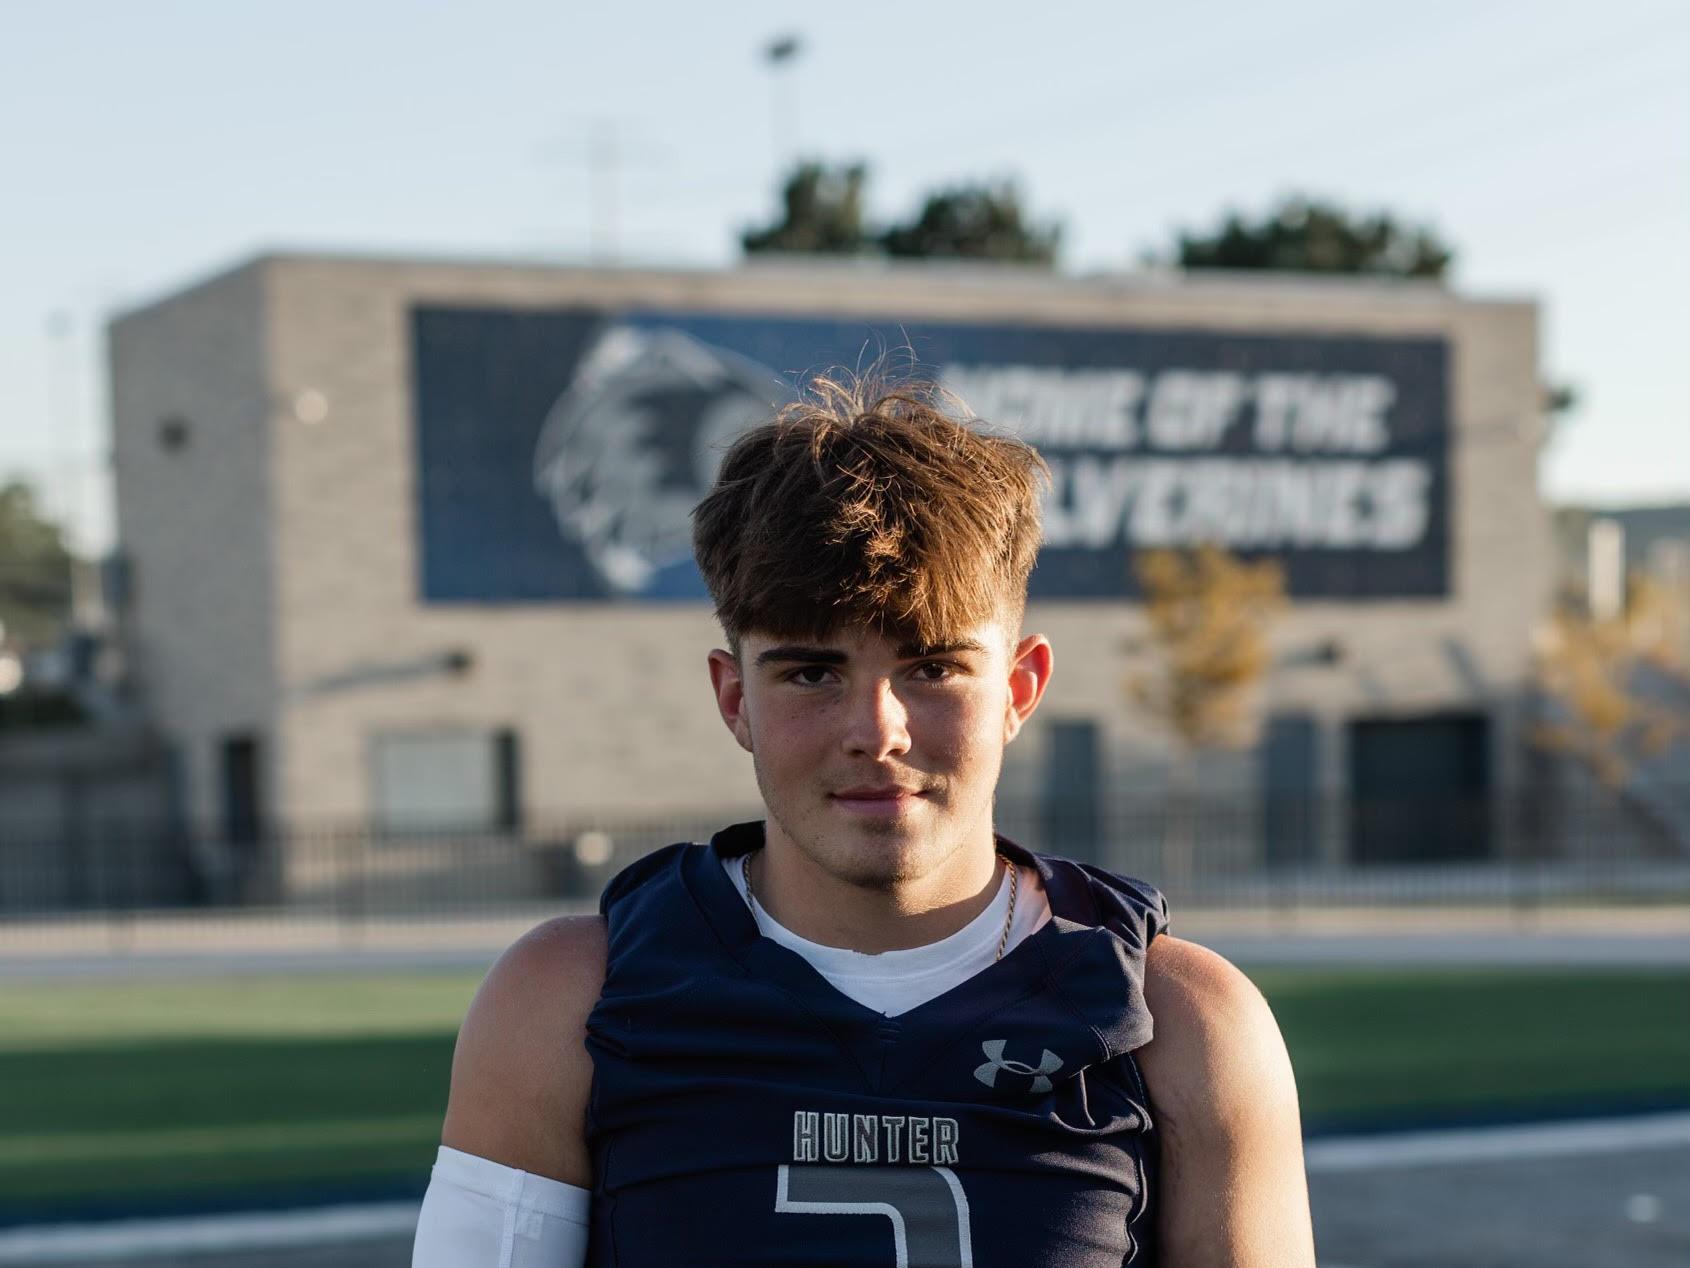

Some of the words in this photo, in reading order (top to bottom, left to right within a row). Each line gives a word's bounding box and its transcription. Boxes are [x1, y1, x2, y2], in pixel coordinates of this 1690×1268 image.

[1146, 369, 1248, 448] OF
[1253, 374, 1397, 451] THE
[1038, 456, 1430, 548] LVERINES
[793, 1110, 959, 1165] HUNTER
